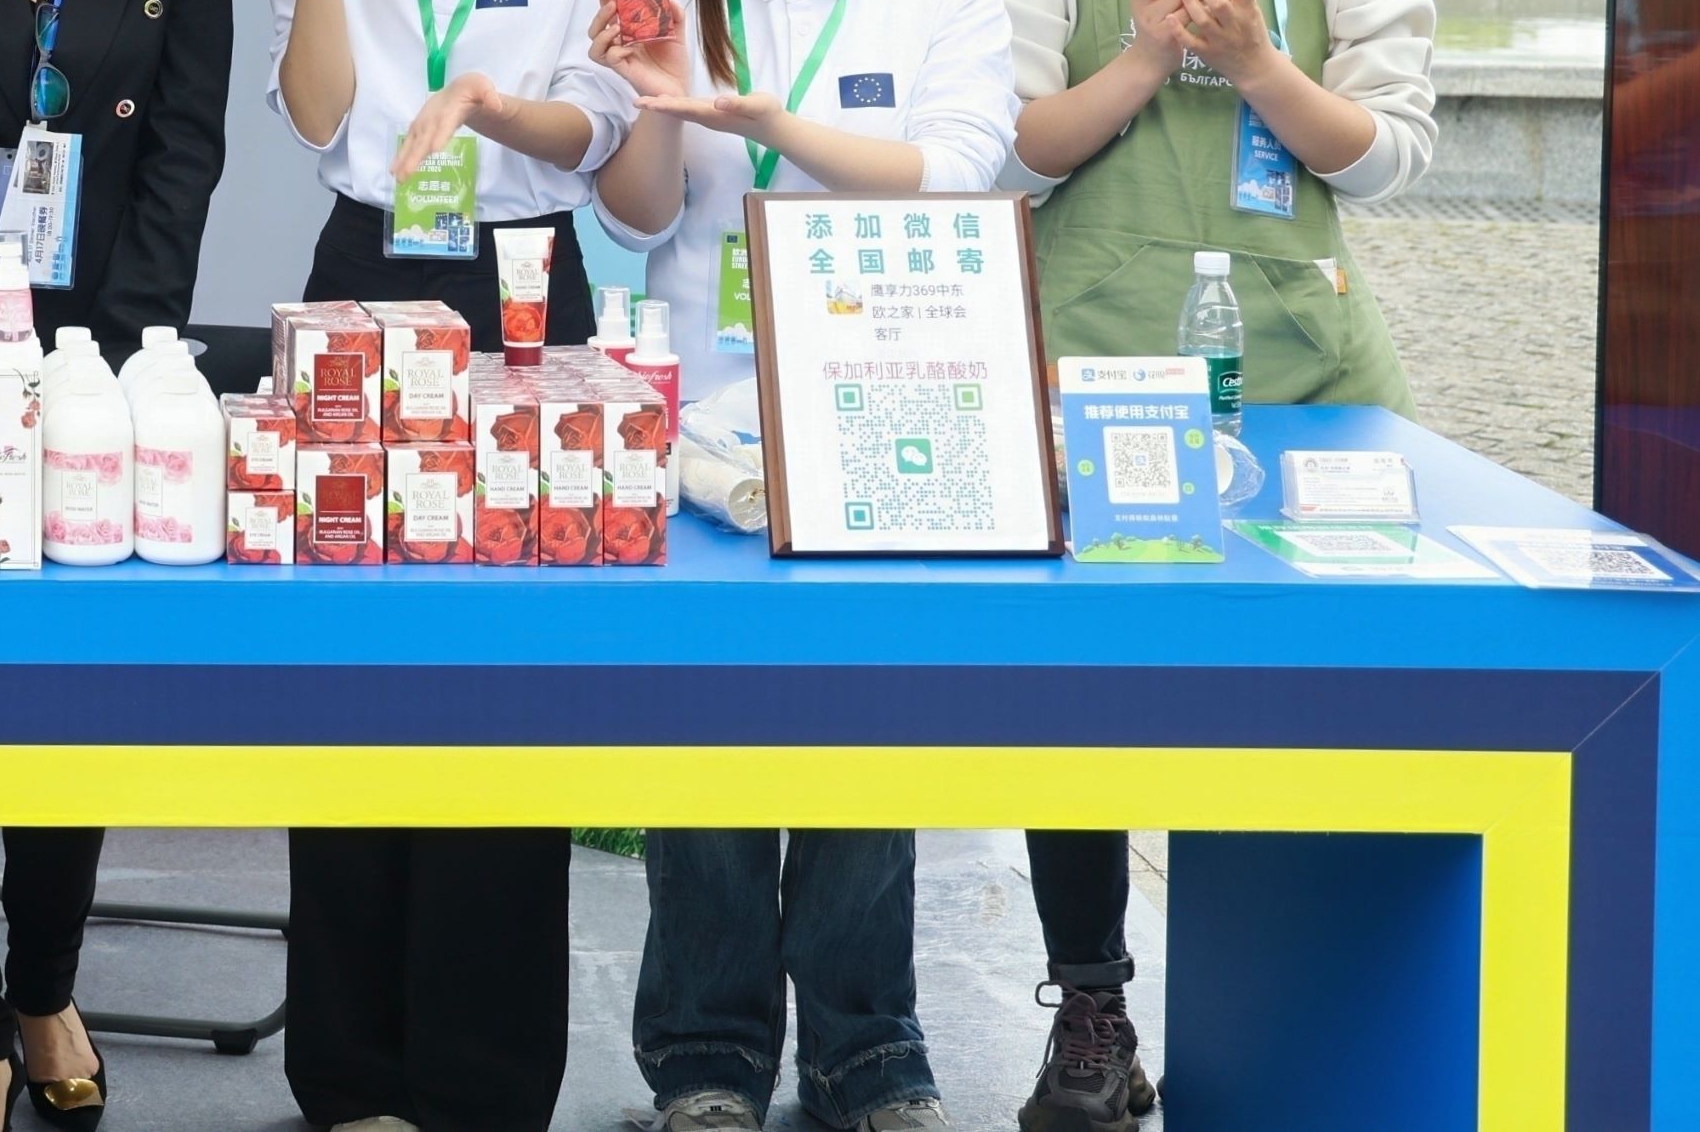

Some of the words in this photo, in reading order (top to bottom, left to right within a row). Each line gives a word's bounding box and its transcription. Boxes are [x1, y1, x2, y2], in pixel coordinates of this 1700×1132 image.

[1254, 149, 1278, 162] SERVICE
[410, 194, 459, 204] VOLUNTEER
[805, 213, 981, 239] 添加微信
[809, 248, 984, 274] 全国邮寄
[875, 327, 902, 342] 客厅
[321, 368, 357, 378] ROYAL
[822, 360, 988, 381] 保加利亚乳酪酸奶
[323, 377, 353, 386] ROSE
[1083, 404, 1190, 420] 推荐使用支付宝
[412, 490, 449, 499] ROYAL
[415, 499, 445, 509] ROSE
